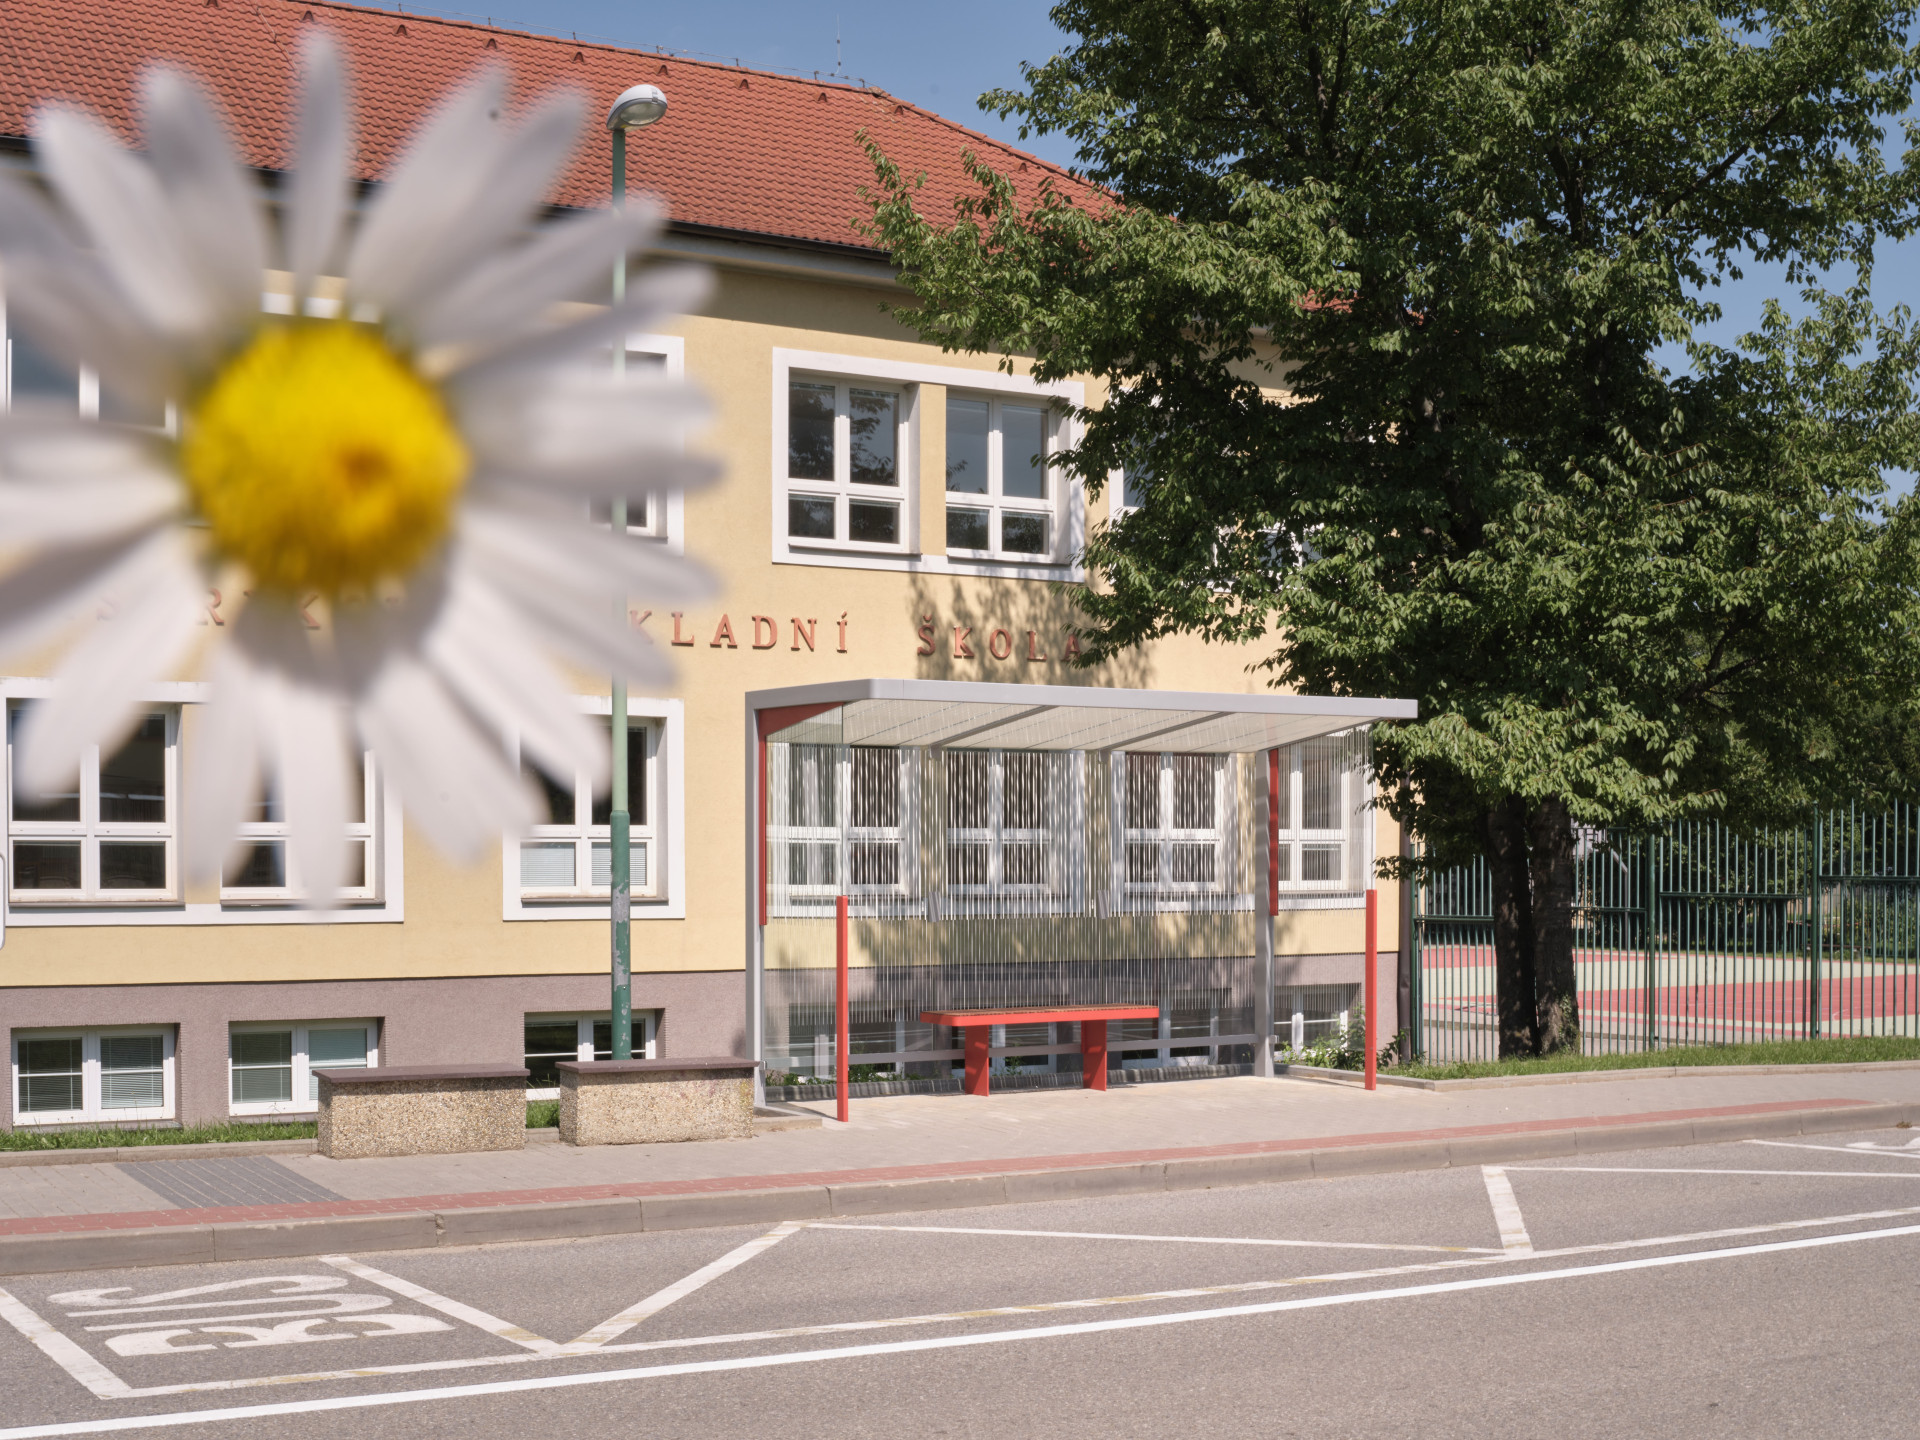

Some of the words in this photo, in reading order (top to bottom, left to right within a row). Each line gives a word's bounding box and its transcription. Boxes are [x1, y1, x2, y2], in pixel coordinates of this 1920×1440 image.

[629, 609, 848, 654] KLADNÍ
[917, 614, 1083, 663] ŠKOLA
[46, 1274, 456, 1357] BUS
